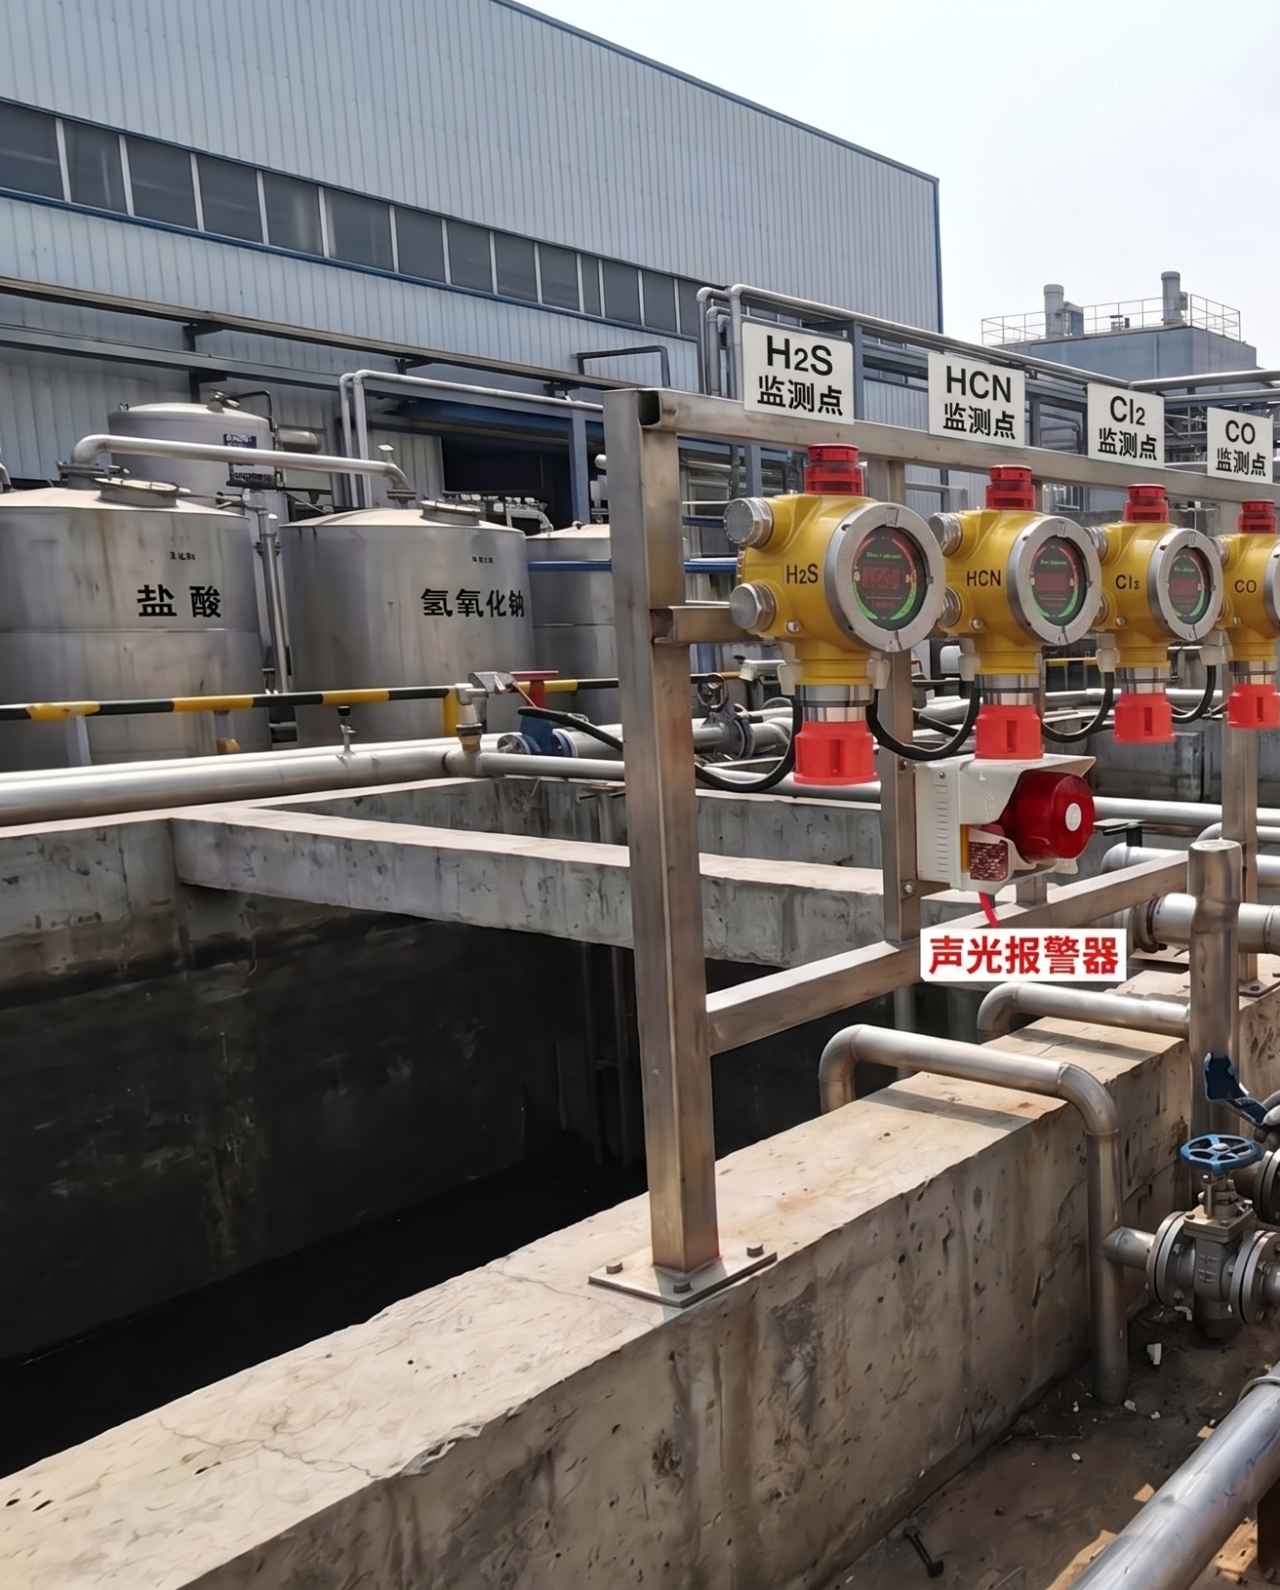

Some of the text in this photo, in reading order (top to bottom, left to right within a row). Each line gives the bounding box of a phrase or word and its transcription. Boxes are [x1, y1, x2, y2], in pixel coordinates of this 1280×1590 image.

[766, 334, 834, 376] H2S
[757, 374, 844, 417] 监测点
[946, 365, 1011, 403] HCN
[943, 402, 1016, 440] 监测点
[1225, 420, 1256, 445] CO
[1098, 427, 1157, 461] 监测点
[1216, 447, 1266, 477] 监测点
[786, 563, 819, 584] H2S
[966, 570, 1002, 587] HCN
[1234, 579, 1257, 594] CO
[137, 584, 221, 618] 盐酸
[420, 588, 525, 618] 氢氧化钠
